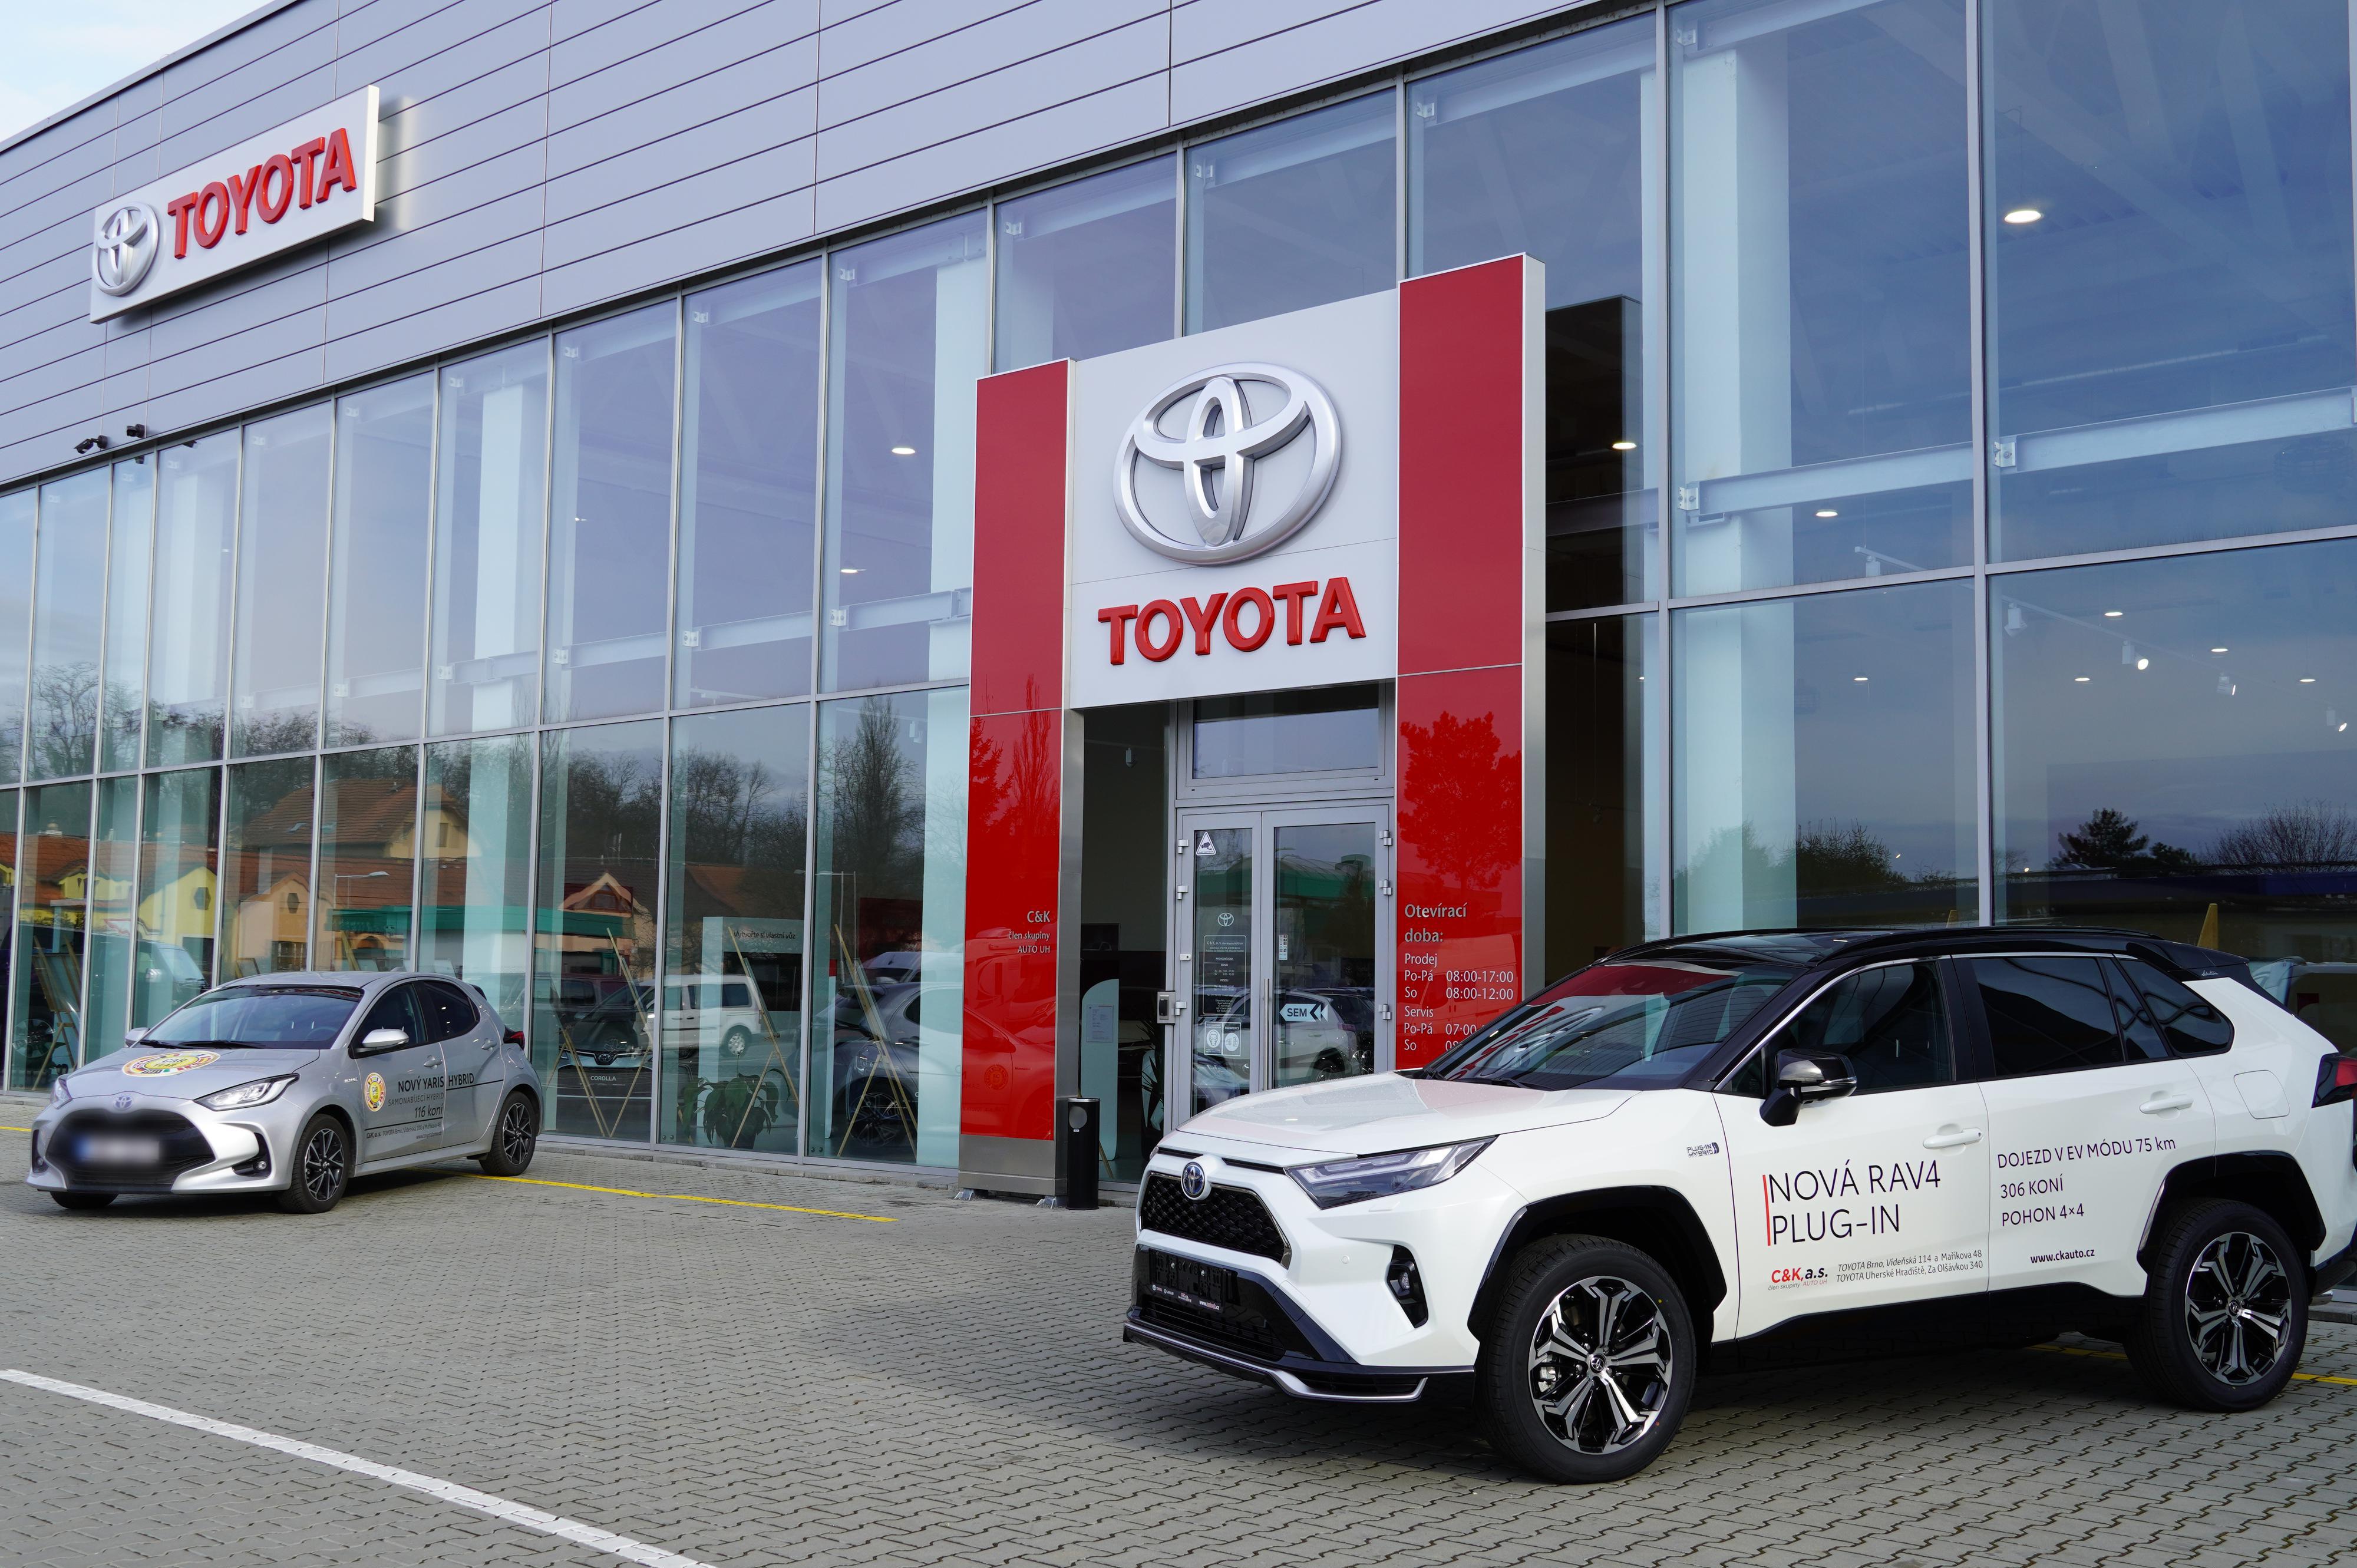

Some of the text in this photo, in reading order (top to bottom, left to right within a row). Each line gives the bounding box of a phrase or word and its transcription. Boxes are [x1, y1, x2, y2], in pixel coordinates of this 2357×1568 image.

[167, 127, 356, 259] TOYOTA
[1098, 576, 1366, 665] TOYOTA
[1026, 910, 1050, 923] C&K
[1404, 902, 1467, 918] Otevírací
[1008, 931, 1050, 942] člen skupiny
[1404, 928, 1443, 942] doba:
[1405, 953, 1438, 968] Prodej
[1405, 969, 1514, 983] Po-Pá 08:00-17:00
[1405, 986, 1514, 1000] So 08:00-12:00
[1287, 1008, 1307, 1017] SEM
[1404, 1006, 1434, 1017] Servis
[1404, 1022, 1432, 1035] Po-Pá
[1404, 1039, 1417, 1051] So
[398, 1073, 474, 1092] NOVÝ YARIS HYBRID
[388, 1092, 444, 1107] SAMONABÍJECÍ HYBRID
[414, 1104, 444, 1118] 116 koní
[1689, 1149, 1713, 1157] HYBRID
[1998, 1137, 2176, 1168] DOJEZD V EV MÓDU 75 km
[1769, 1159, 1940, 1203] NOVÁ RAV4
[2001, 1173, 2063, 1199] 306 KONÍ
[2002, 1206, 2056, 1226] POHON
[1772, 1204, 1899, 1245] PLUG-IN
[1838, 1261, 1866, 1272] TOYOTA
[1867, 1259, 1884, 1269] Brno,
[1886, 1255, 1917, 1267] Vídeňská
[1918, 1254, 1931, 1264] 114
[1941, 1250, 1972, 1261] Maříkova
[1973, 1249, 1982, 1258] 48
[2031, 1249, 2095, 1263] www.ckauto.cz
[1771, 1267, 1828, 1283] C&K, a.s.
[1836, 1259, 1983, 1283] TOYOTA Uherské Hradiště, Za Olšávkou 340
